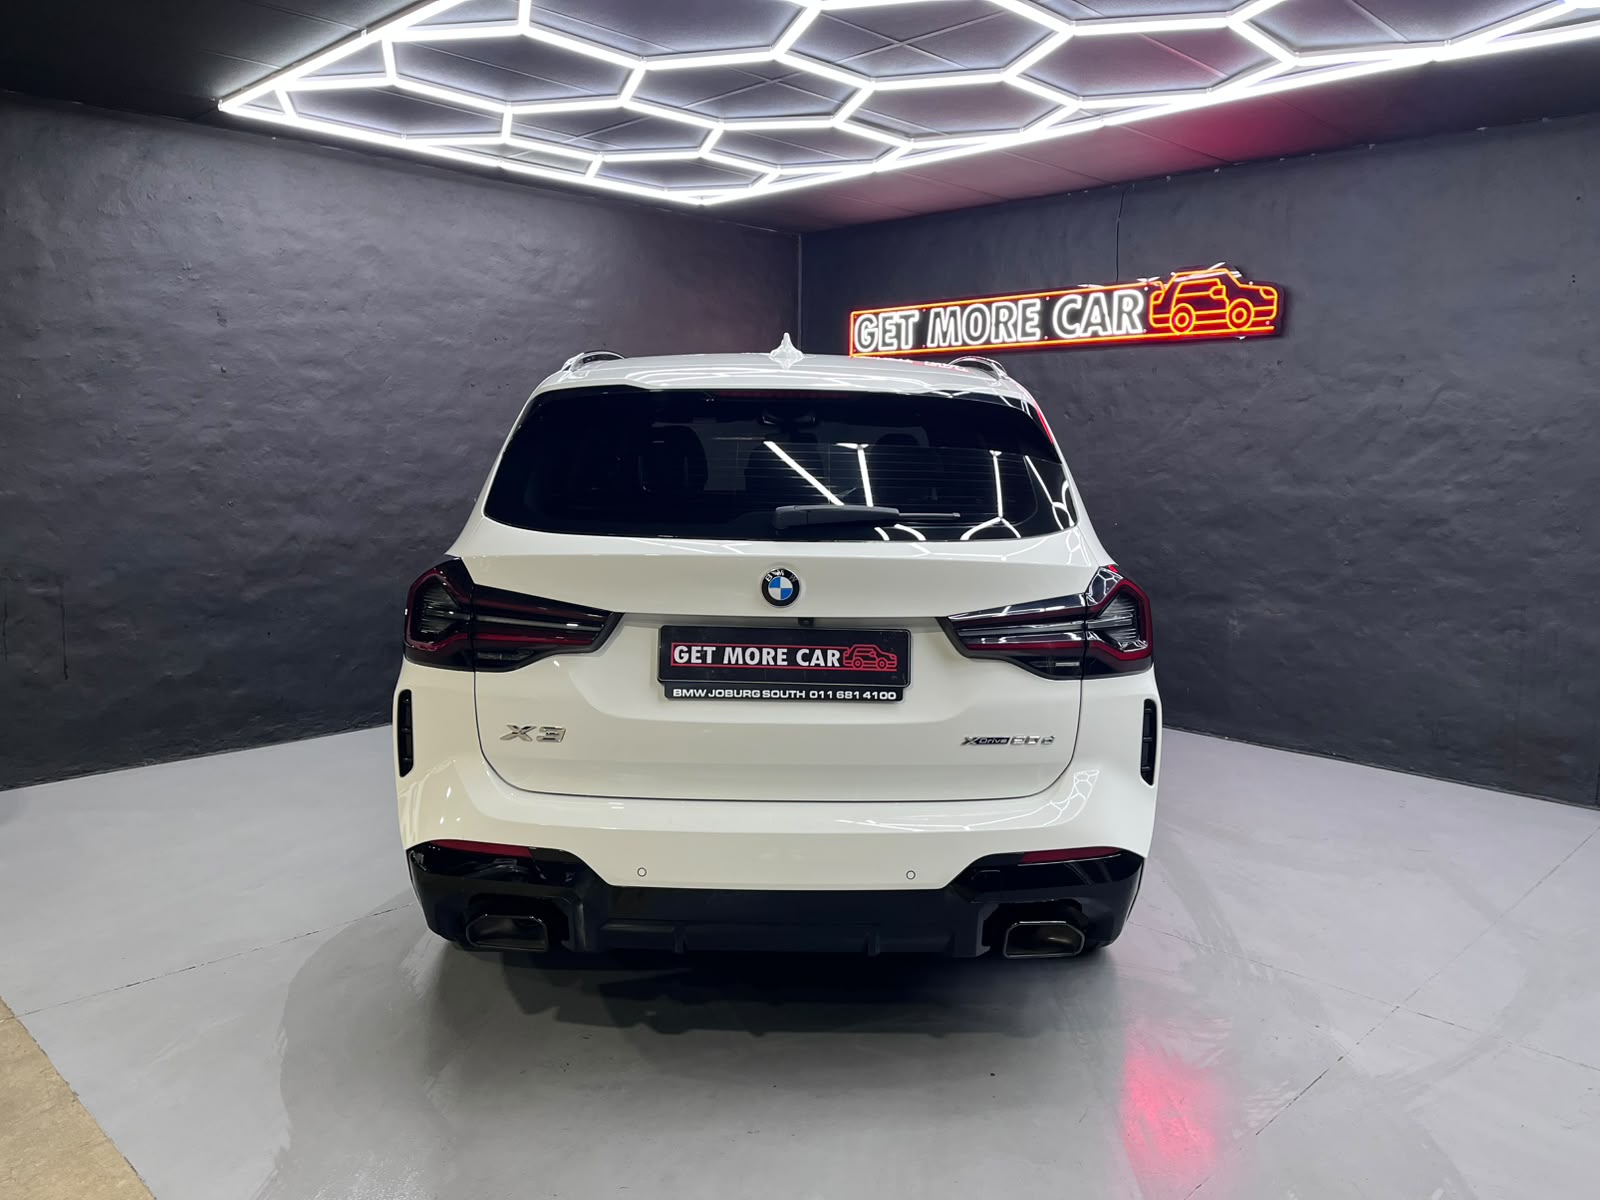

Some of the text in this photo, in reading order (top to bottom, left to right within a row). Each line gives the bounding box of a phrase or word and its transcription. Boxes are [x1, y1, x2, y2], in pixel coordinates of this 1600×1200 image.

[854, 290, 1144, 352] GET MORE CAR
[673, 646, 841, 668] GET MORE CAR
[672, 688, 897, 700] BMW JOBURG SOUTH 011 681 4100
[499, 724, 566, 742] X3
